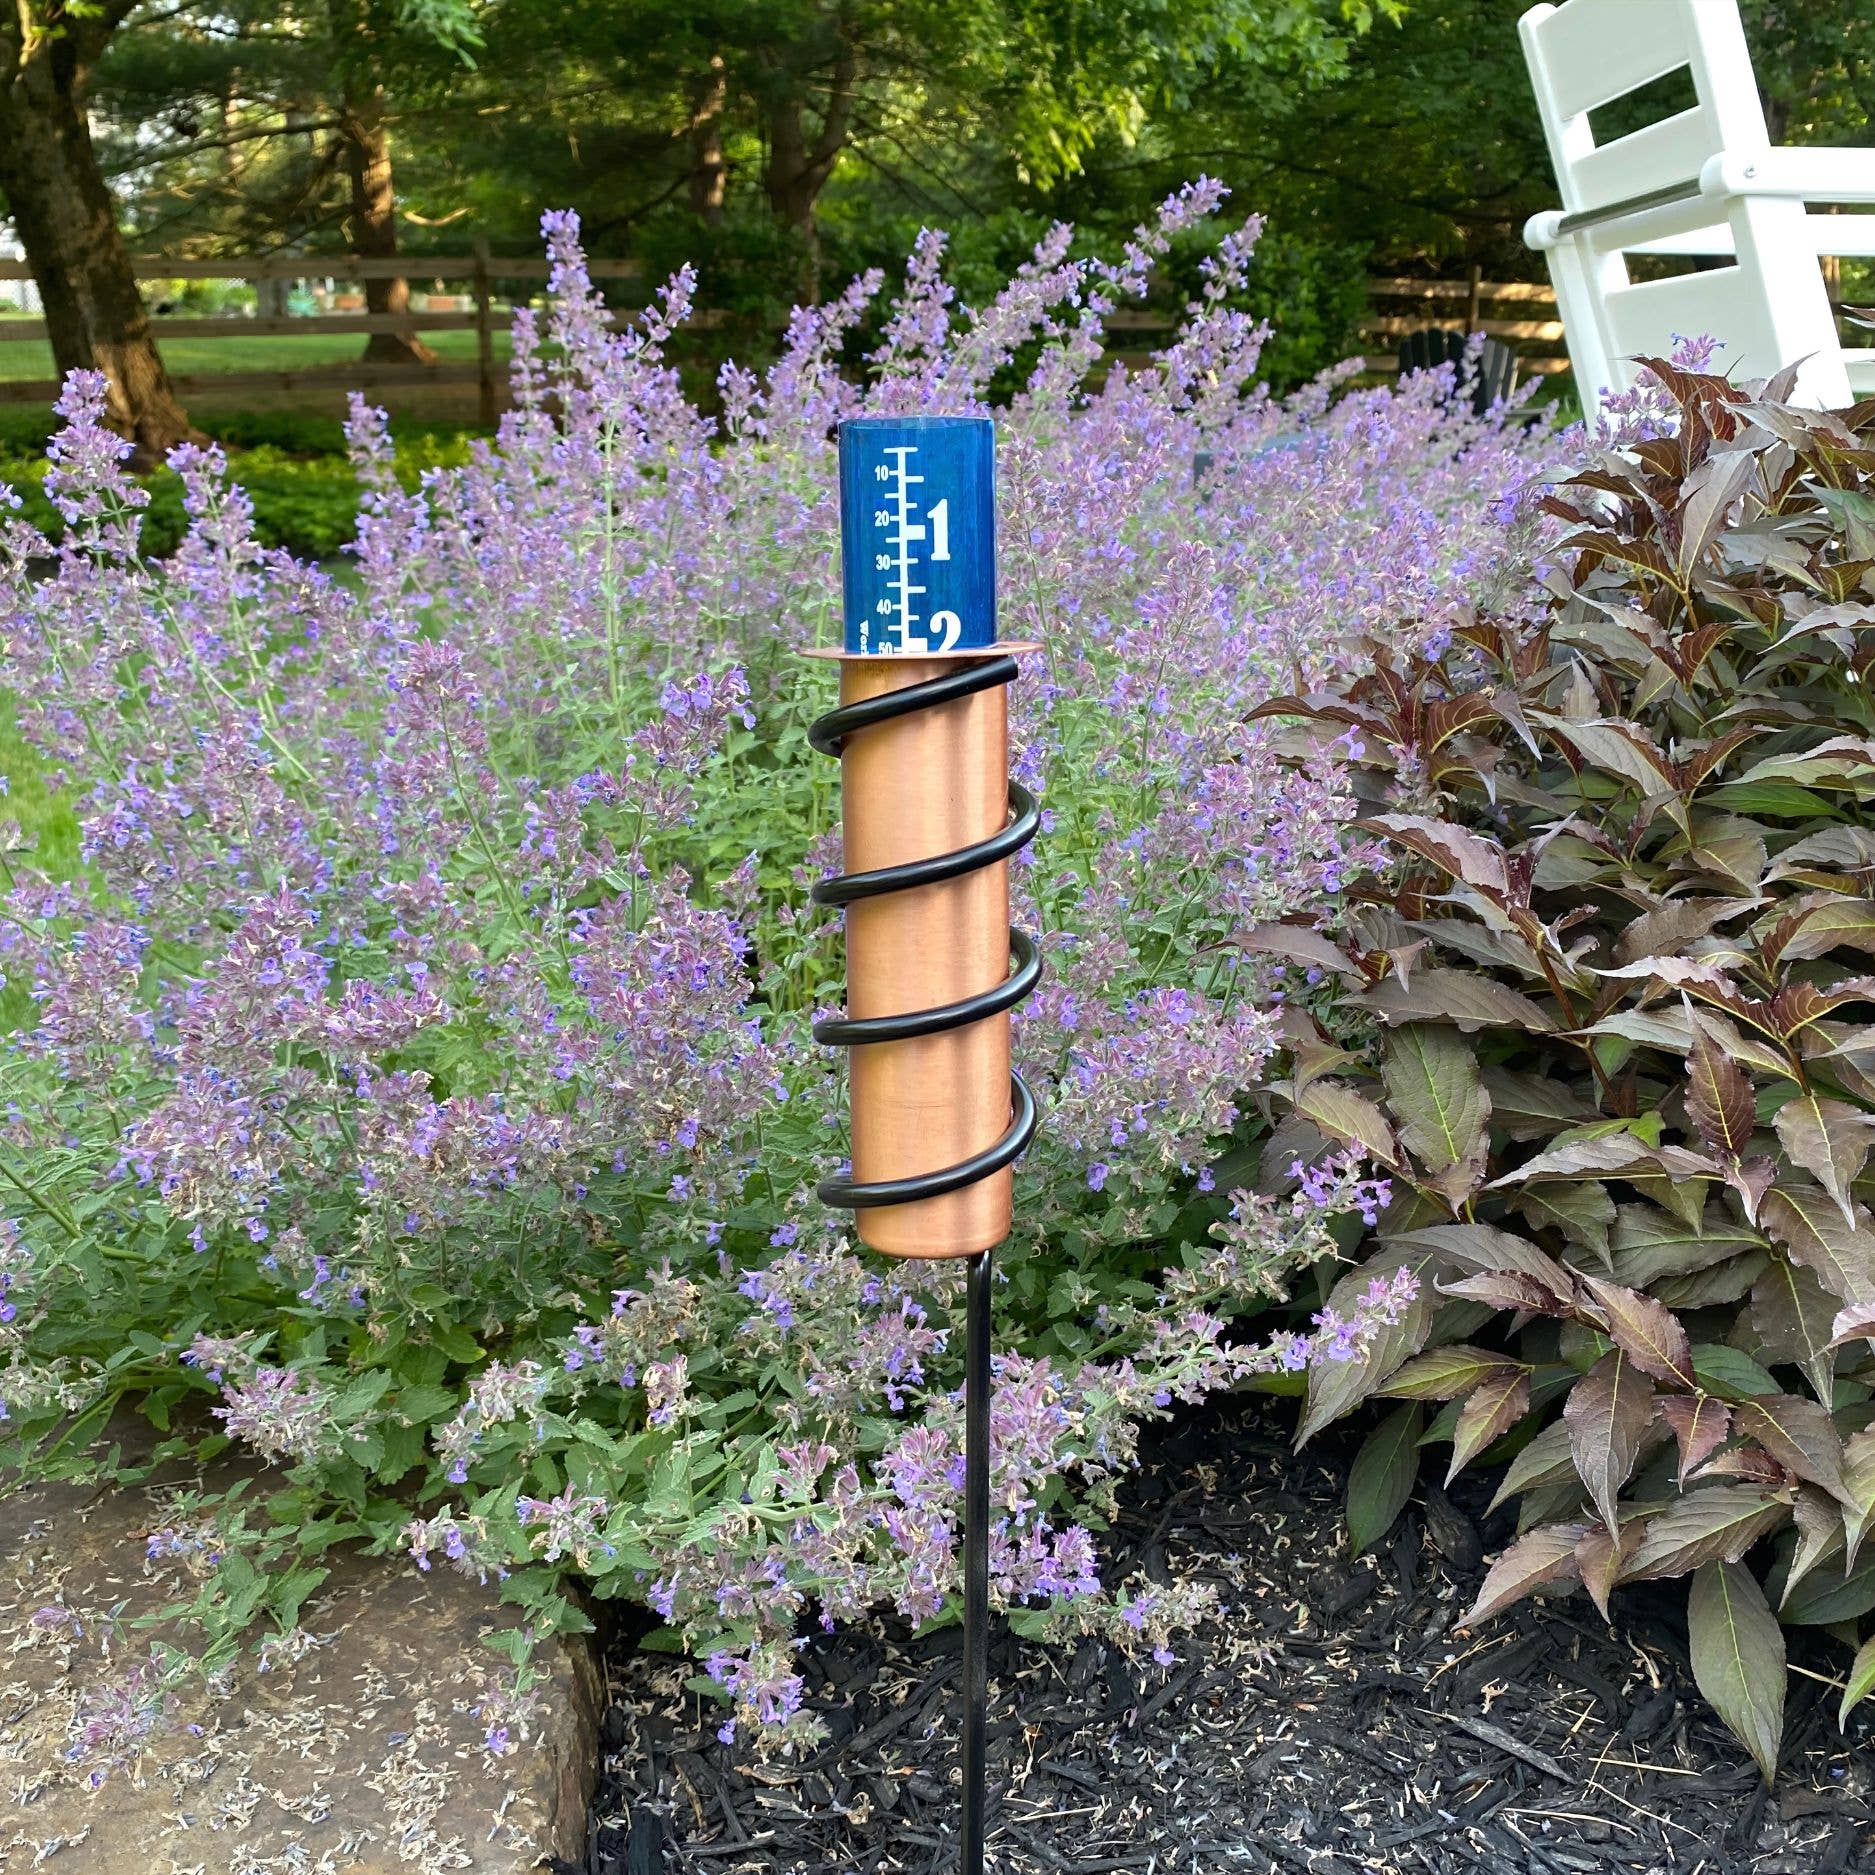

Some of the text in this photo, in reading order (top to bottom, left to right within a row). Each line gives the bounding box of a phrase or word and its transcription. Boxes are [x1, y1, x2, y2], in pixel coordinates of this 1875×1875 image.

[874, 465, 889, 481] 10
[874, 510, 890, 527] 20
[927, 498, 951, 561] 1
[875, 554, 891, 571] 30
[876, 599, 892, 615] 40
[929, 610, 962, 655] 2
[878, 641, 893, 655] 50
